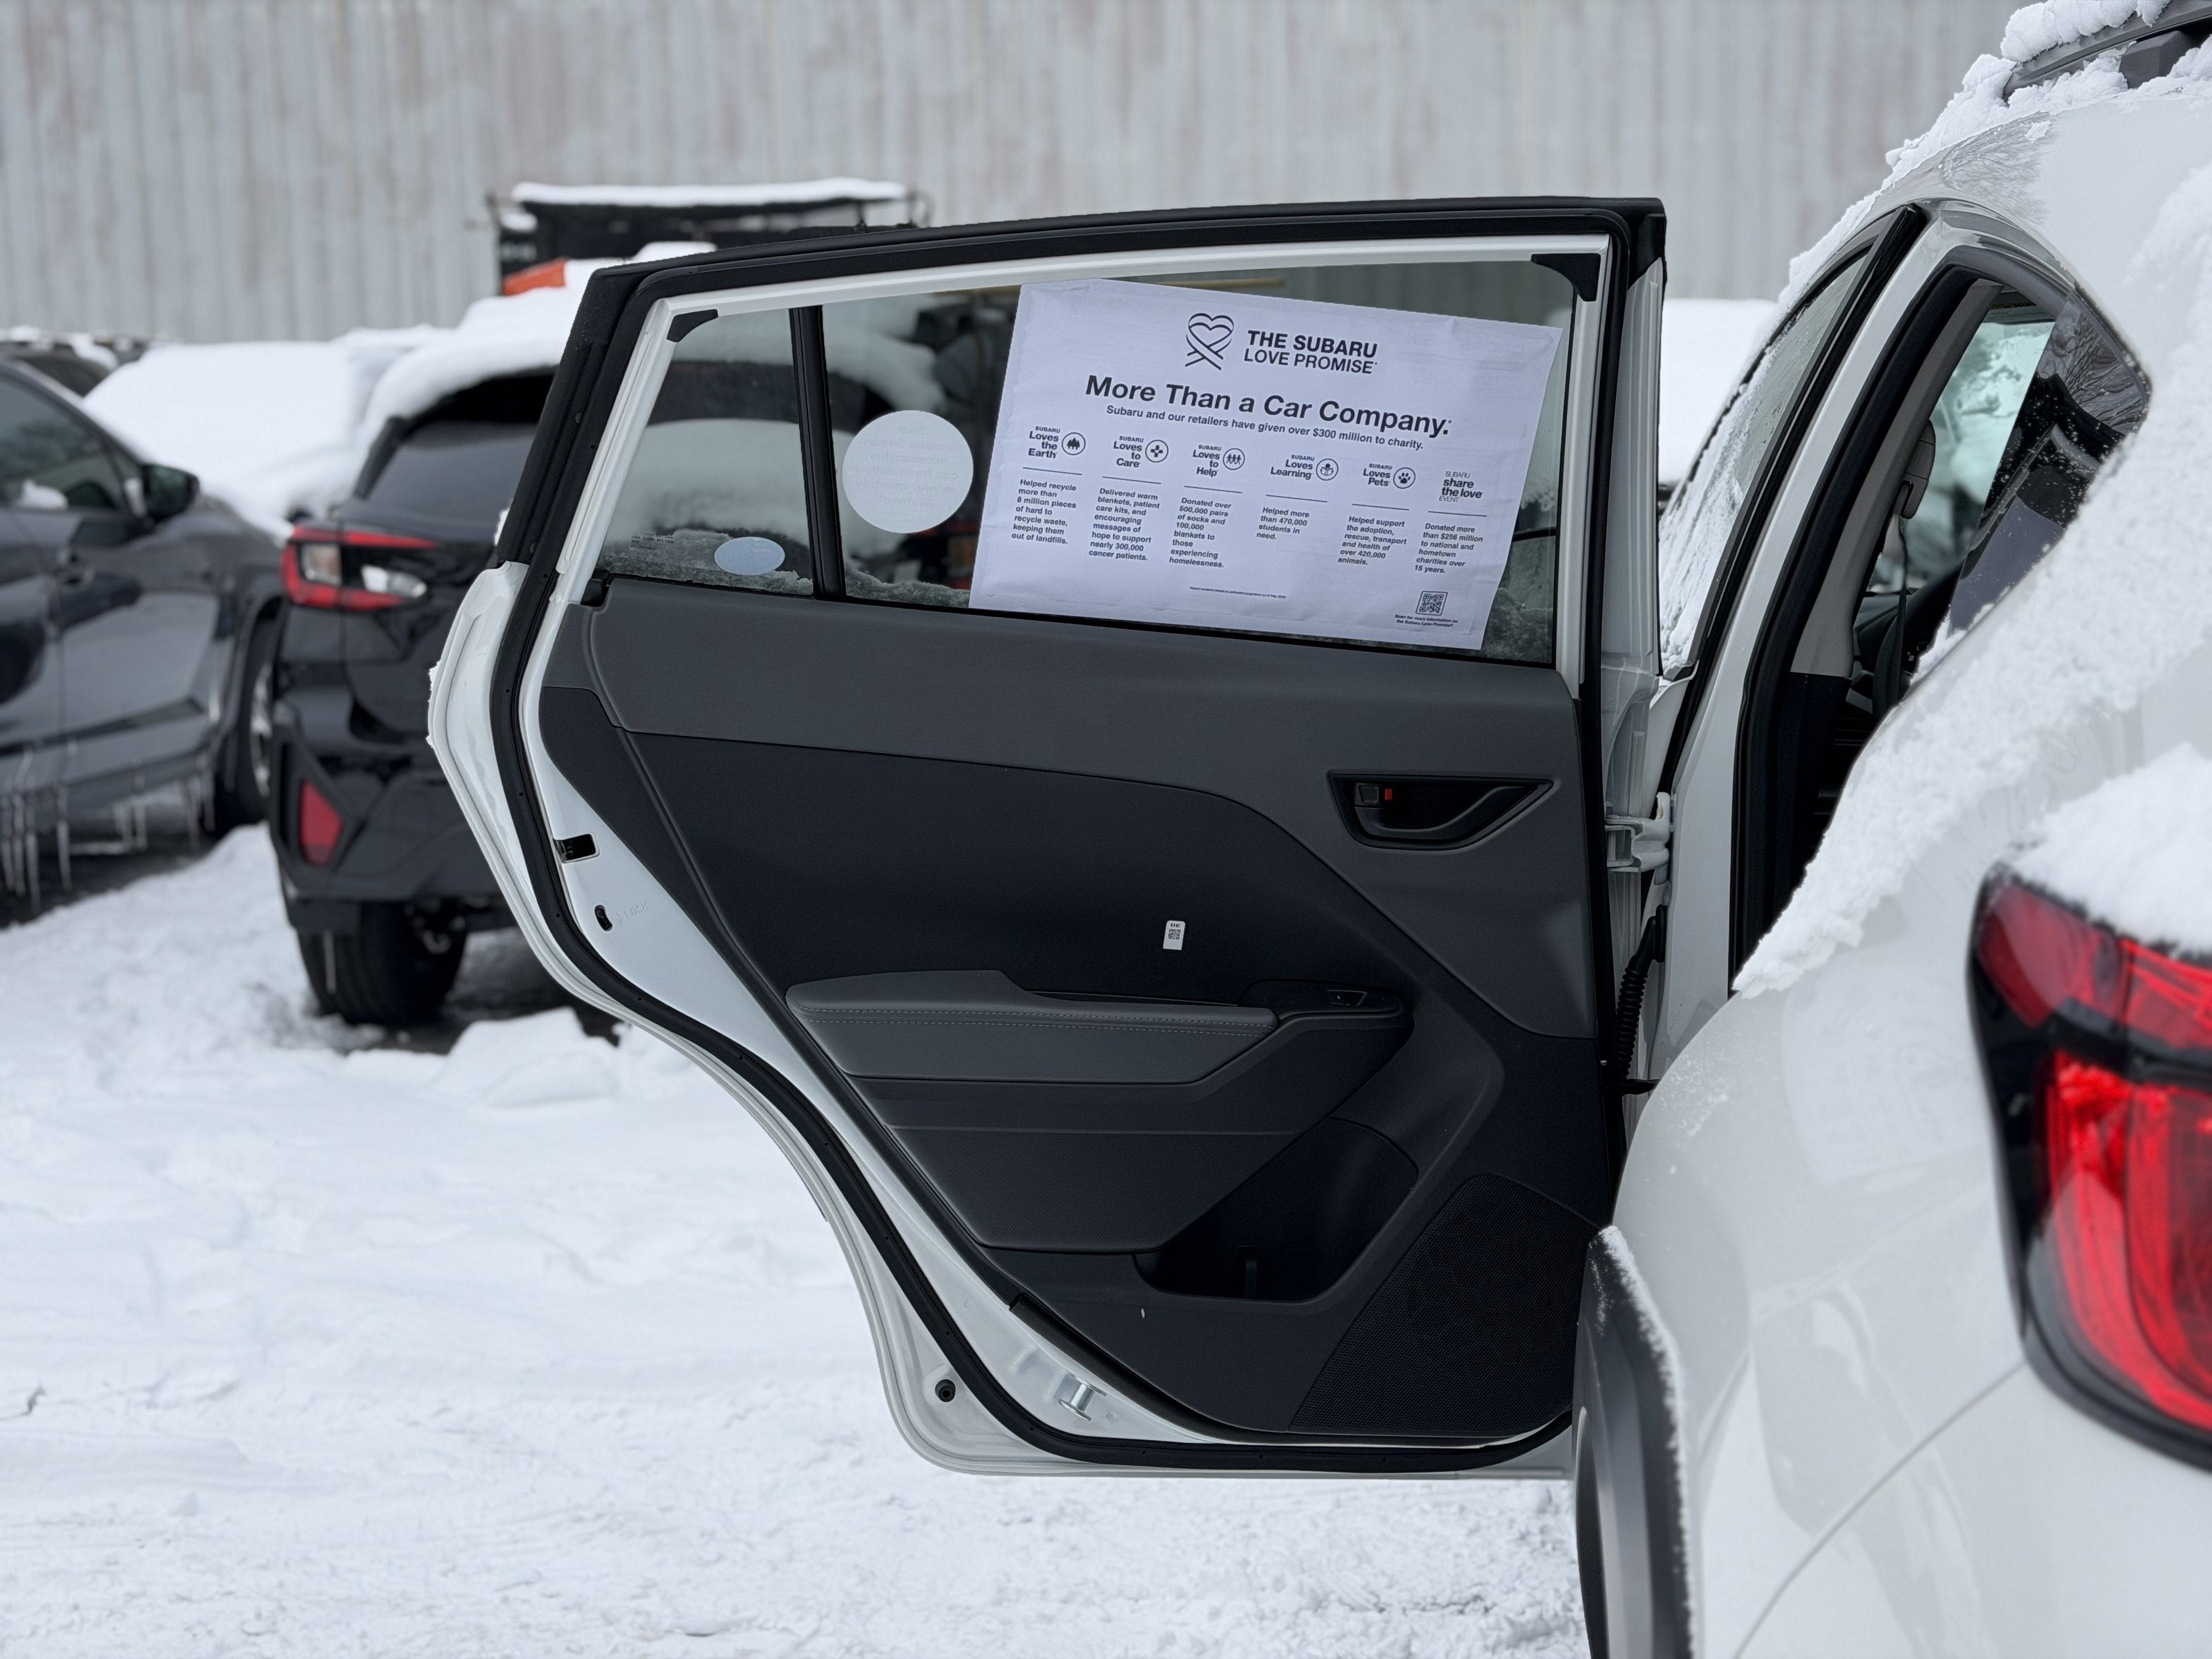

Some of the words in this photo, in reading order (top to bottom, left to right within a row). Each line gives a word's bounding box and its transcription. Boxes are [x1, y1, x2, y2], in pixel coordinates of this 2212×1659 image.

[1248, 330, 1288, 349] THE
[1293, 335, 1378, 358] SUBARU
[1244, 348, 1290, 366] LOVE
[1085, 375, 1156, 402] More
[1166, 383, 1231, 410] Than
[1238, 397, 1255, 413] a
[1264, 395, 1313, 419] Car
[1107, 405, 1143, 417] Subaru
[1146, 411, 1166, 420] and
[1167, 414, 1186, 422] our
[1187, 416, 1229, 427] retailers
[1231, 419, 1256, 430] have
[1257, 424, 1285, 433] given
[1288, 427, 1311, 436] over
[1312, 428, 1336, 439] $300
[1339, 432, 1373, 443] million
[1375, 436, 1385, 444] to
[1387, 437, 1424, 450] charity.
[1029, 431, 1059, 442] Loves
[1041, 441, 1058, 450] the
[1113, 441, 1142, 452] Loves
[1131, 452, 1141, 460] to
[1192, 449, 1220, 460] Loves
[1209, 460, 1219, 468] to
[1285, 459, 1313, 470] Loves
[1363, 468, 1391, 479] Loves
[1020, 479, 1047, 488] Helped
[1049, 483, 1077, 492] recycle
[1443, 477, 1474, 489] share
[1099, 488, 1136, 498] Delivered
[1441, 487, 1459, 497] the
[1023, 497, 1049, 506] million
[1051, 500, 1076, 509] pieces
[1097, 496, 1132, 506] blankets,
[1133, 501, 1160, 509] patient
[1181, 497, 1214, 507] Donated
[1025, 506, 1043, 515] hard
[1114, 506, 1130, 515] kits,
[1179, 505, 1208, 515] 500,000
[1262, 507, 1289, 516] Helped
[1014, 516, 1042, 524] recycle
[1043, 518, 1068, 527] waste,
[1094, 514, 1142, 526] encouraging
[1279, 517, 1307, 526] 470,000
[1348, 516, 1375, 525] Helped
[1376, 520, 1405, 528] support
[1013, 523, 1043, 534] keeping
[1045, 527, 1064, 535] them
[1093, 523, 1131, 533] messages
[1176, 522, 1204, 531] 100,000
[1259, 524, 1291, 533] students
[1359, 526, 1394, 536] adoption,
[1425, 523, 1455, 532] Donated
[1036, 534, 1068, 545] landfills.
[1092, 531, 1111, 540] hope
[1122, 535, 1152, 544] support
[1173, 530, 1205, 539] blankets
[1344, 534, 1371, 542] rescue,
[1373, 535, 1407, 545] transport
[1459, 534, 1483, 543] million
[1090, 541, 1114, 550] nearly
[1115, 543, 1144, 552] 300,000
[1172, 539, 1193, 547] those
[1357, 542, 1380, 550] health
[1115, 552, 1148, 561] patients.
[1170, 549, 1218, 560] experiencing
[1358, 550, 1386, 559] 420,000
[1418, 548, 1457, 558] hometown
[1169, 556, 1224, 568] homelessness.
[1338, 557, 1368, 565] animals.
[1416, 557, 1447, 566] charities
